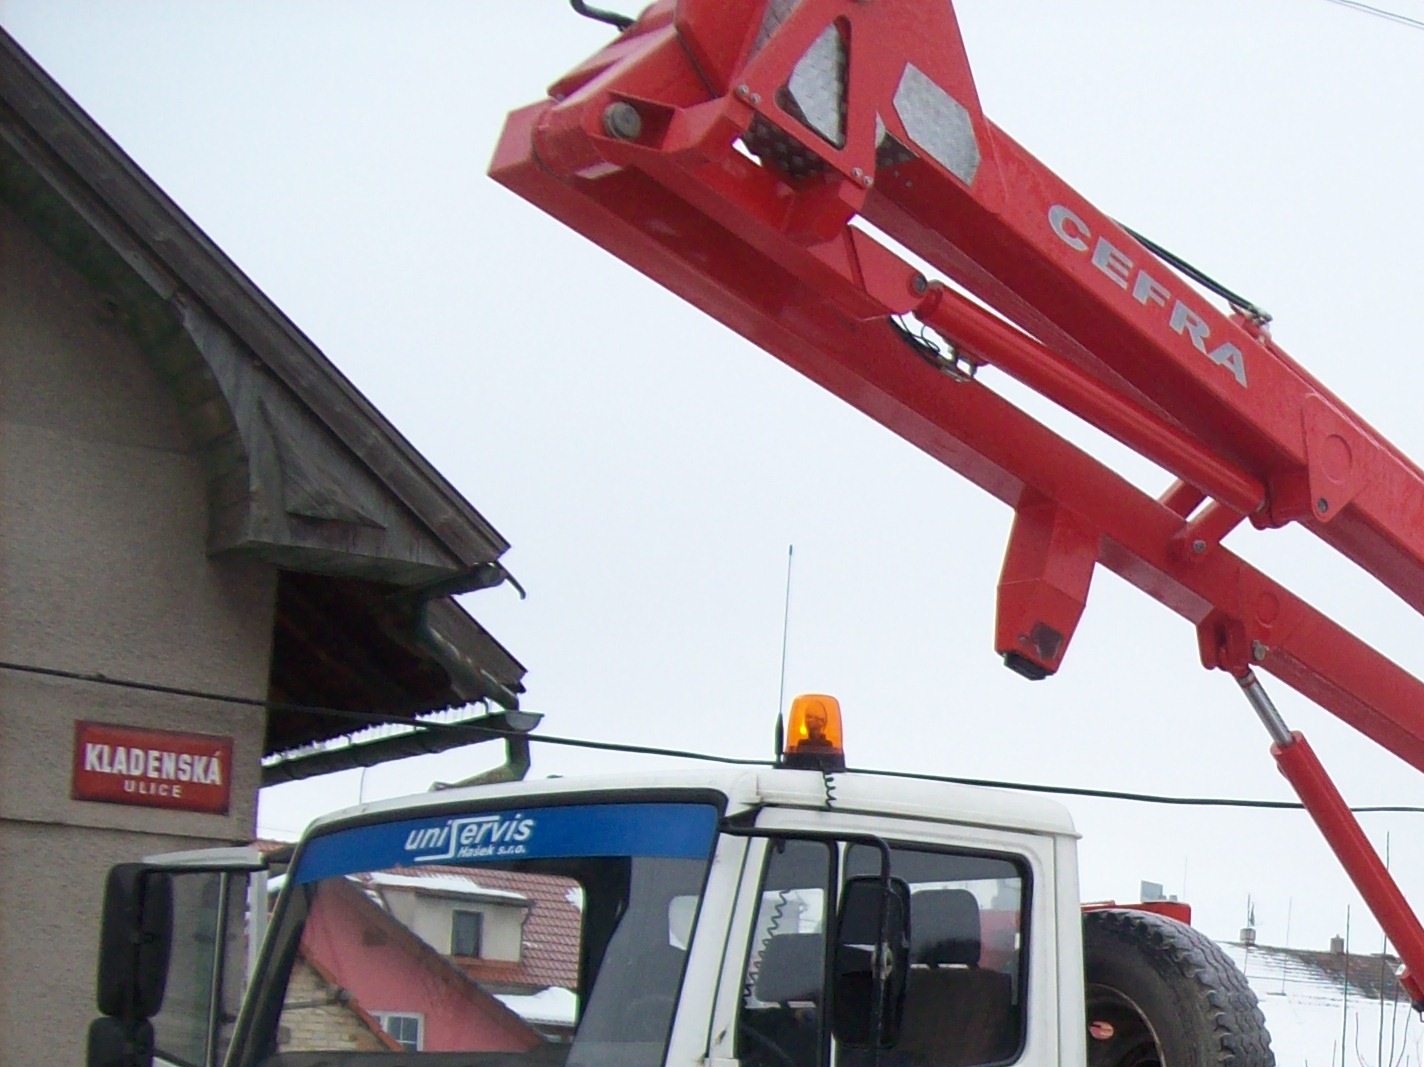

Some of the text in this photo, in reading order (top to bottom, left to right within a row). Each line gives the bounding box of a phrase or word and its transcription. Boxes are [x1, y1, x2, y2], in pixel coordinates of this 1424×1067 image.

[1048, 204, 1248, 389] CEFRA
[84, 742, 223, 786] KLADENSKÁ
[124, 779, 182, 798] ULICE
